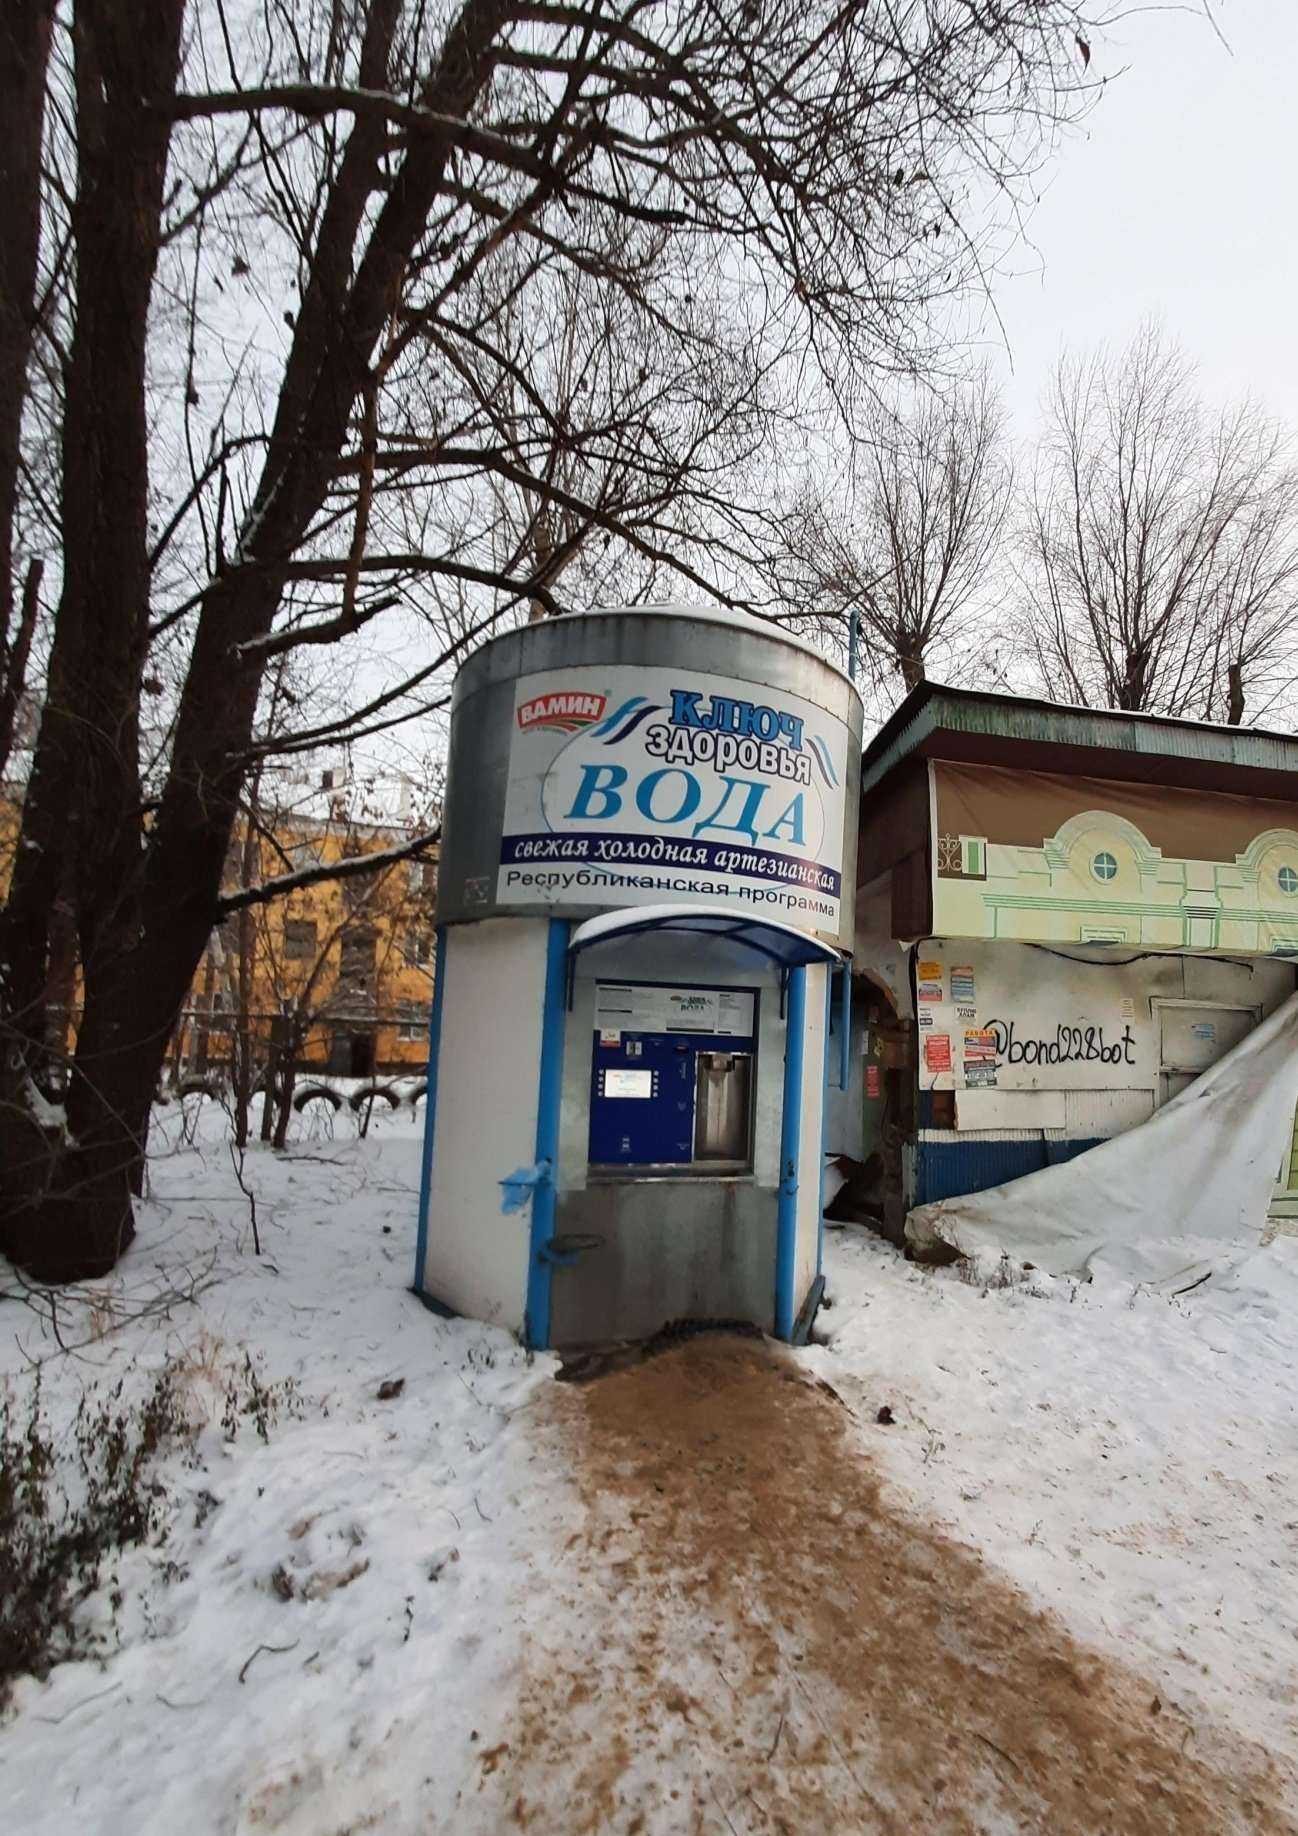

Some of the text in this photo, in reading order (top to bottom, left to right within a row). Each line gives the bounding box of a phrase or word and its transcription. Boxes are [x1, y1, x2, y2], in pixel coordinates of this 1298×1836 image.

[521, 695, 601, 724] ВАМИН
[670, 689, 805, 750] КЛЮЧ
[563, 763, 807, 847] ВОДА
[514, 836, 835, 891] свежая холодная артезианская
[506, 869, 835, 917] Республиканская программа
